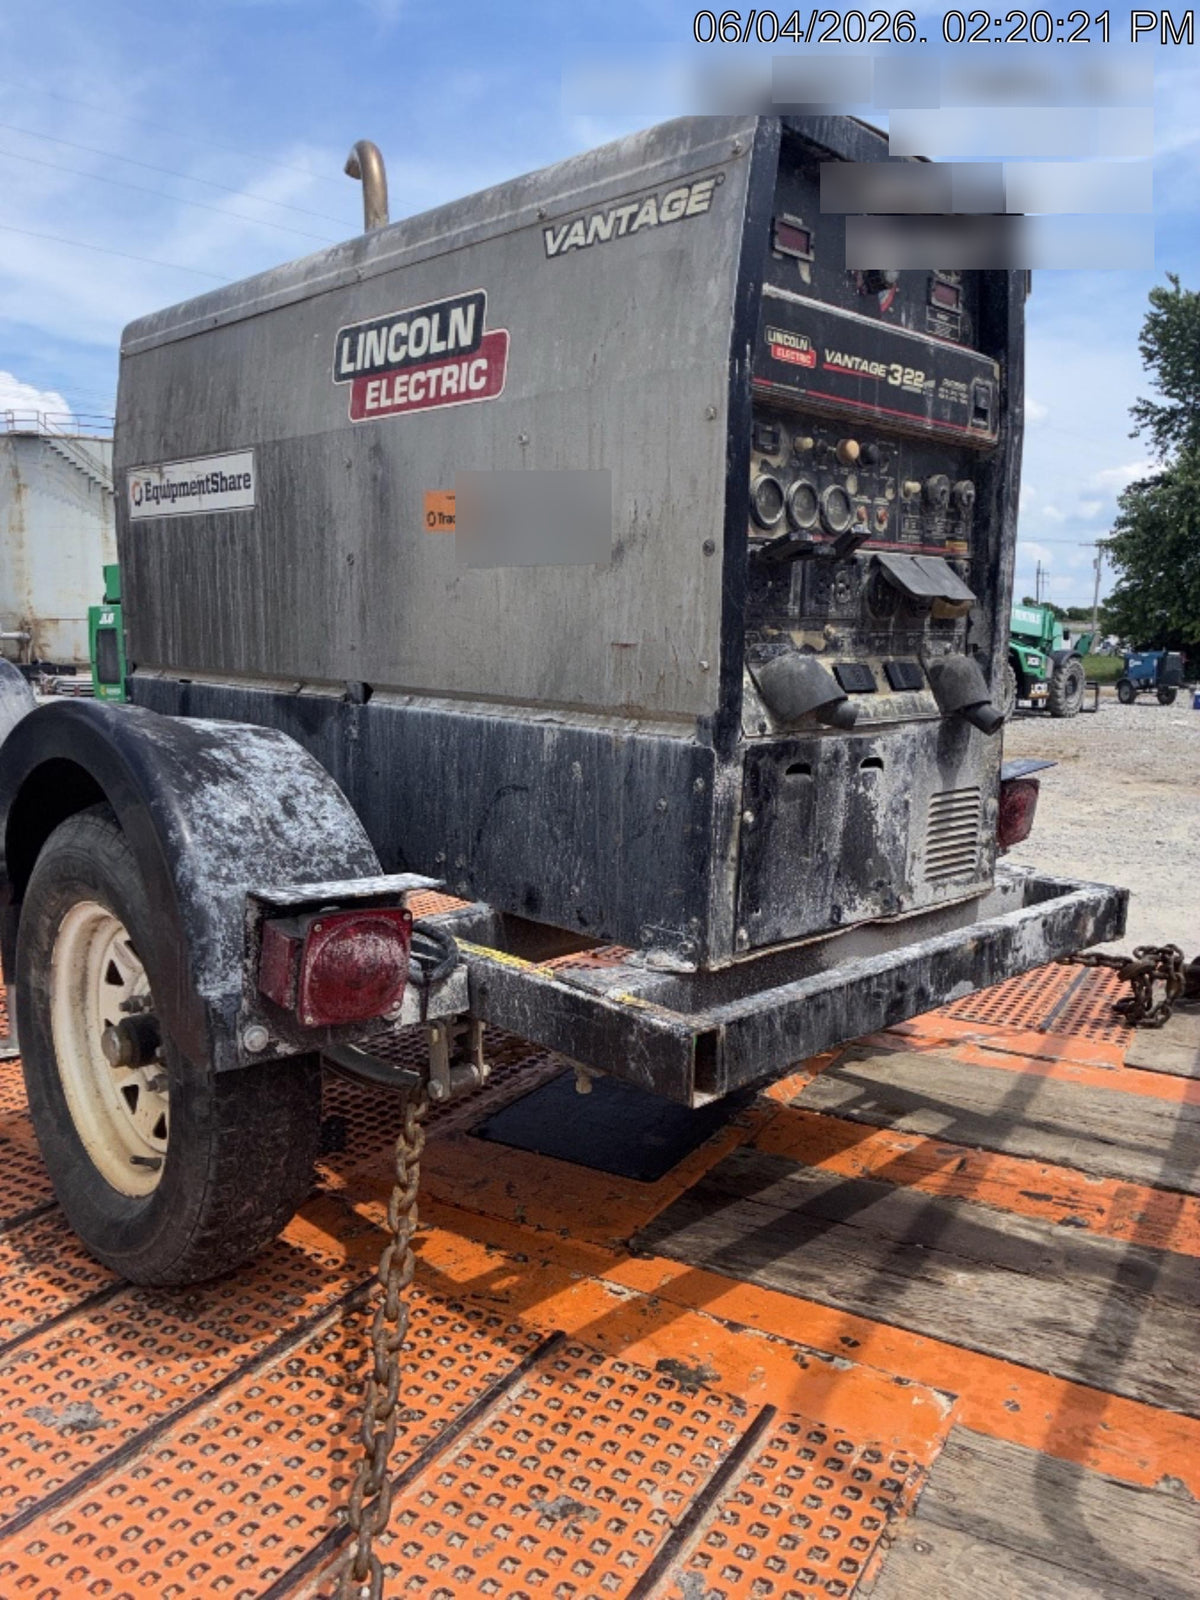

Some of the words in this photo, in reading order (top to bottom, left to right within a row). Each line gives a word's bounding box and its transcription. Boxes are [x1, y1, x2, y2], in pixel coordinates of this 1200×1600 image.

[543, 177, 717, 257] VANTAGE
[339, 303, 476, 374] LINCOLN
[767, 330, 808, 351] LINCOLN
[777, 348, 812, 364] ELECTRIC
[365, 358, 488, 410] ELECTRIC
[824, 348, 886, 377] VANTAGE
[887, 363, 925, 388] 322
[144, 471, 251, 505] EquipmentShare
